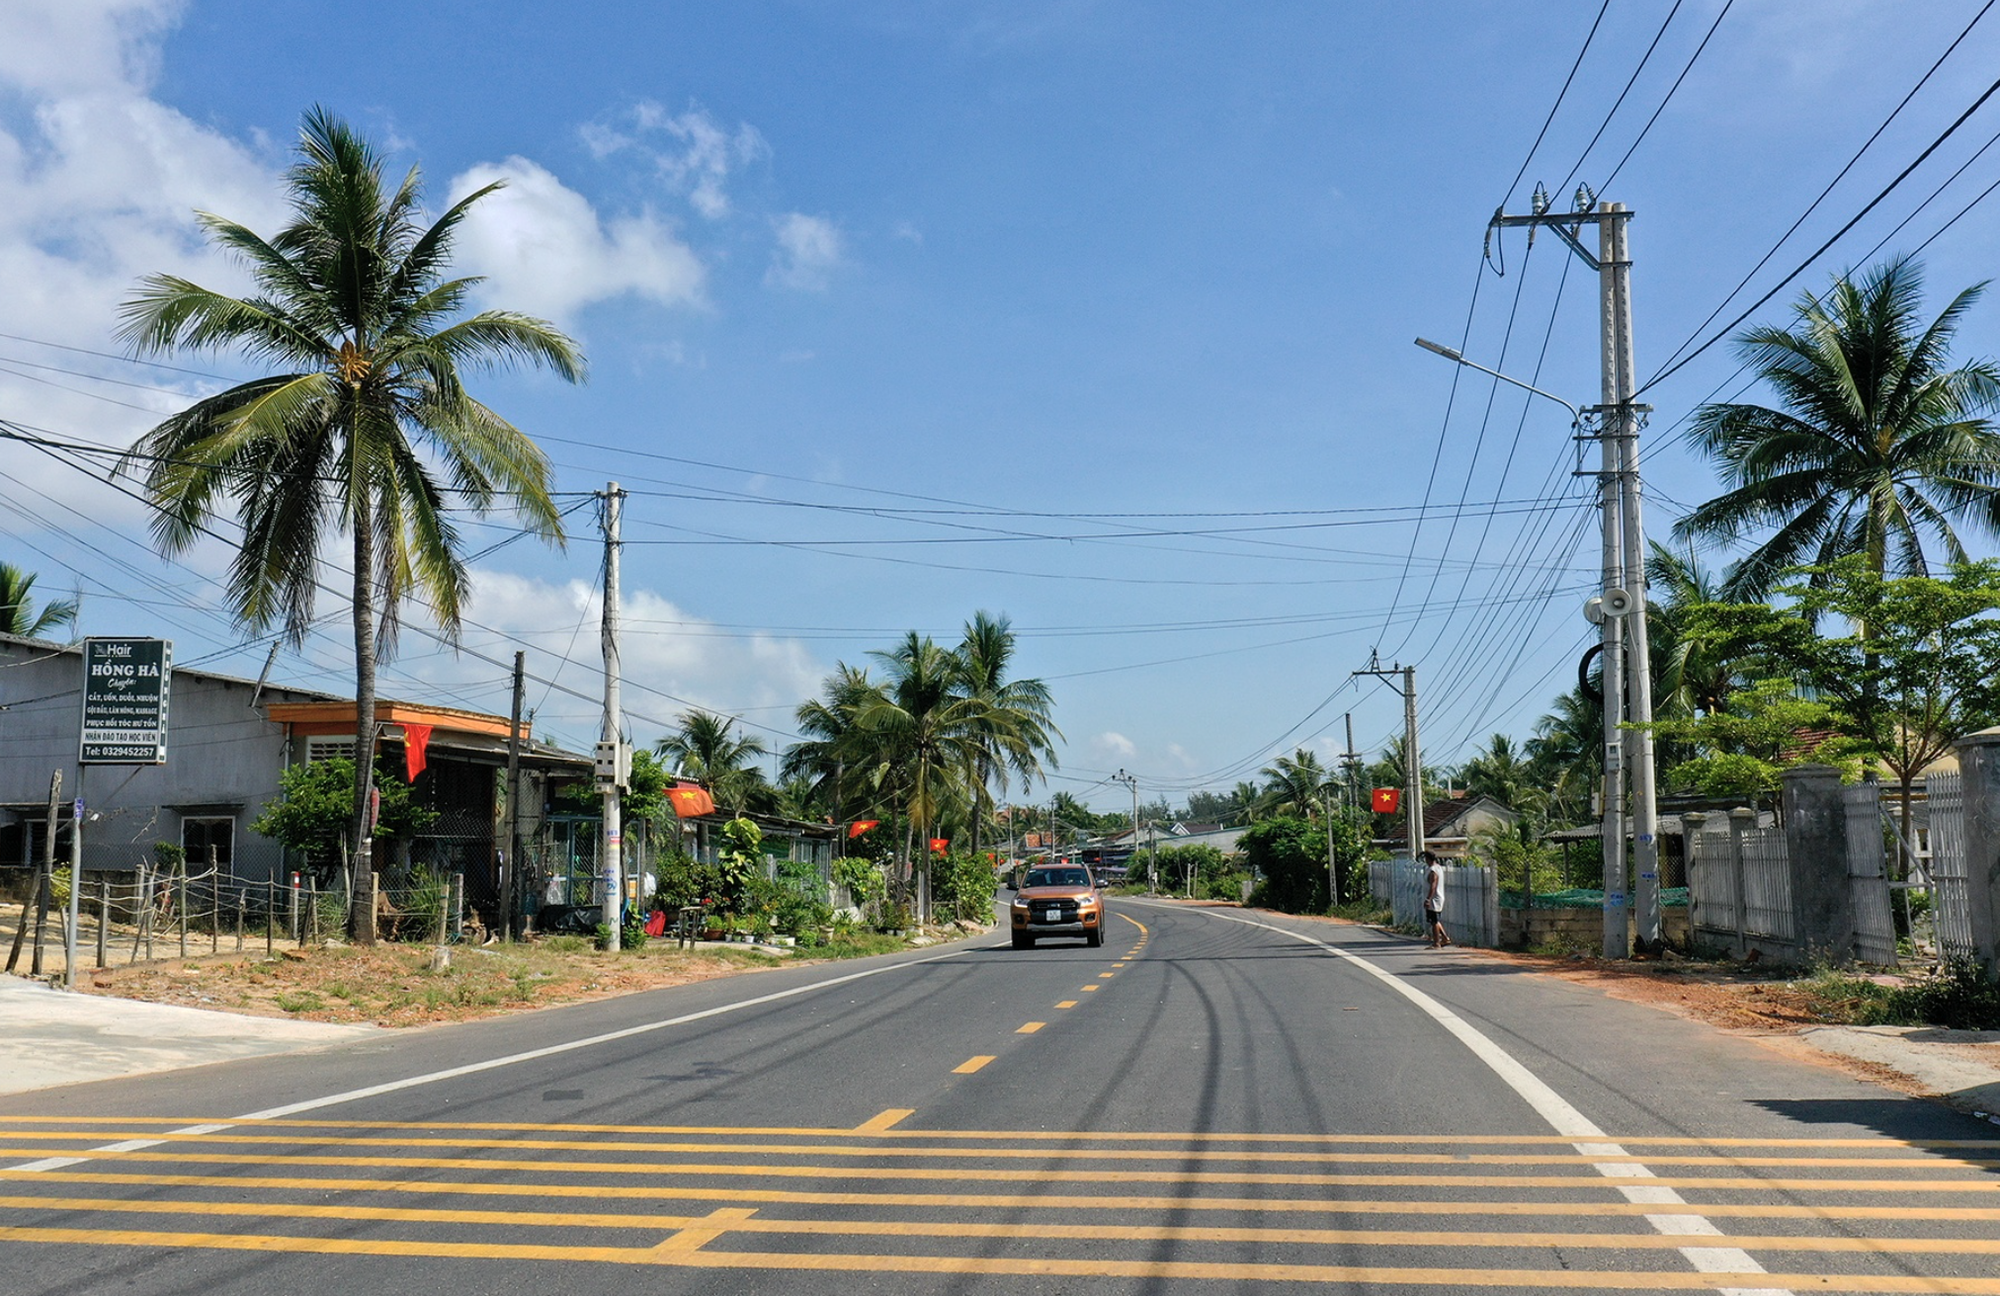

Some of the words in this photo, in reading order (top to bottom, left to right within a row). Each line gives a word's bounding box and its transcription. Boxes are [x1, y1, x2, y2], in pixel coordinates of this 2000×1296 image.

[107, 644, 132, 655] Hair
[92, 659, 135, 676] HỒNG
[138, 662, 159, 676] HÀ
[85, 747, 100, 756] Tel:
[102, 747, 154, 756] 0329452257
